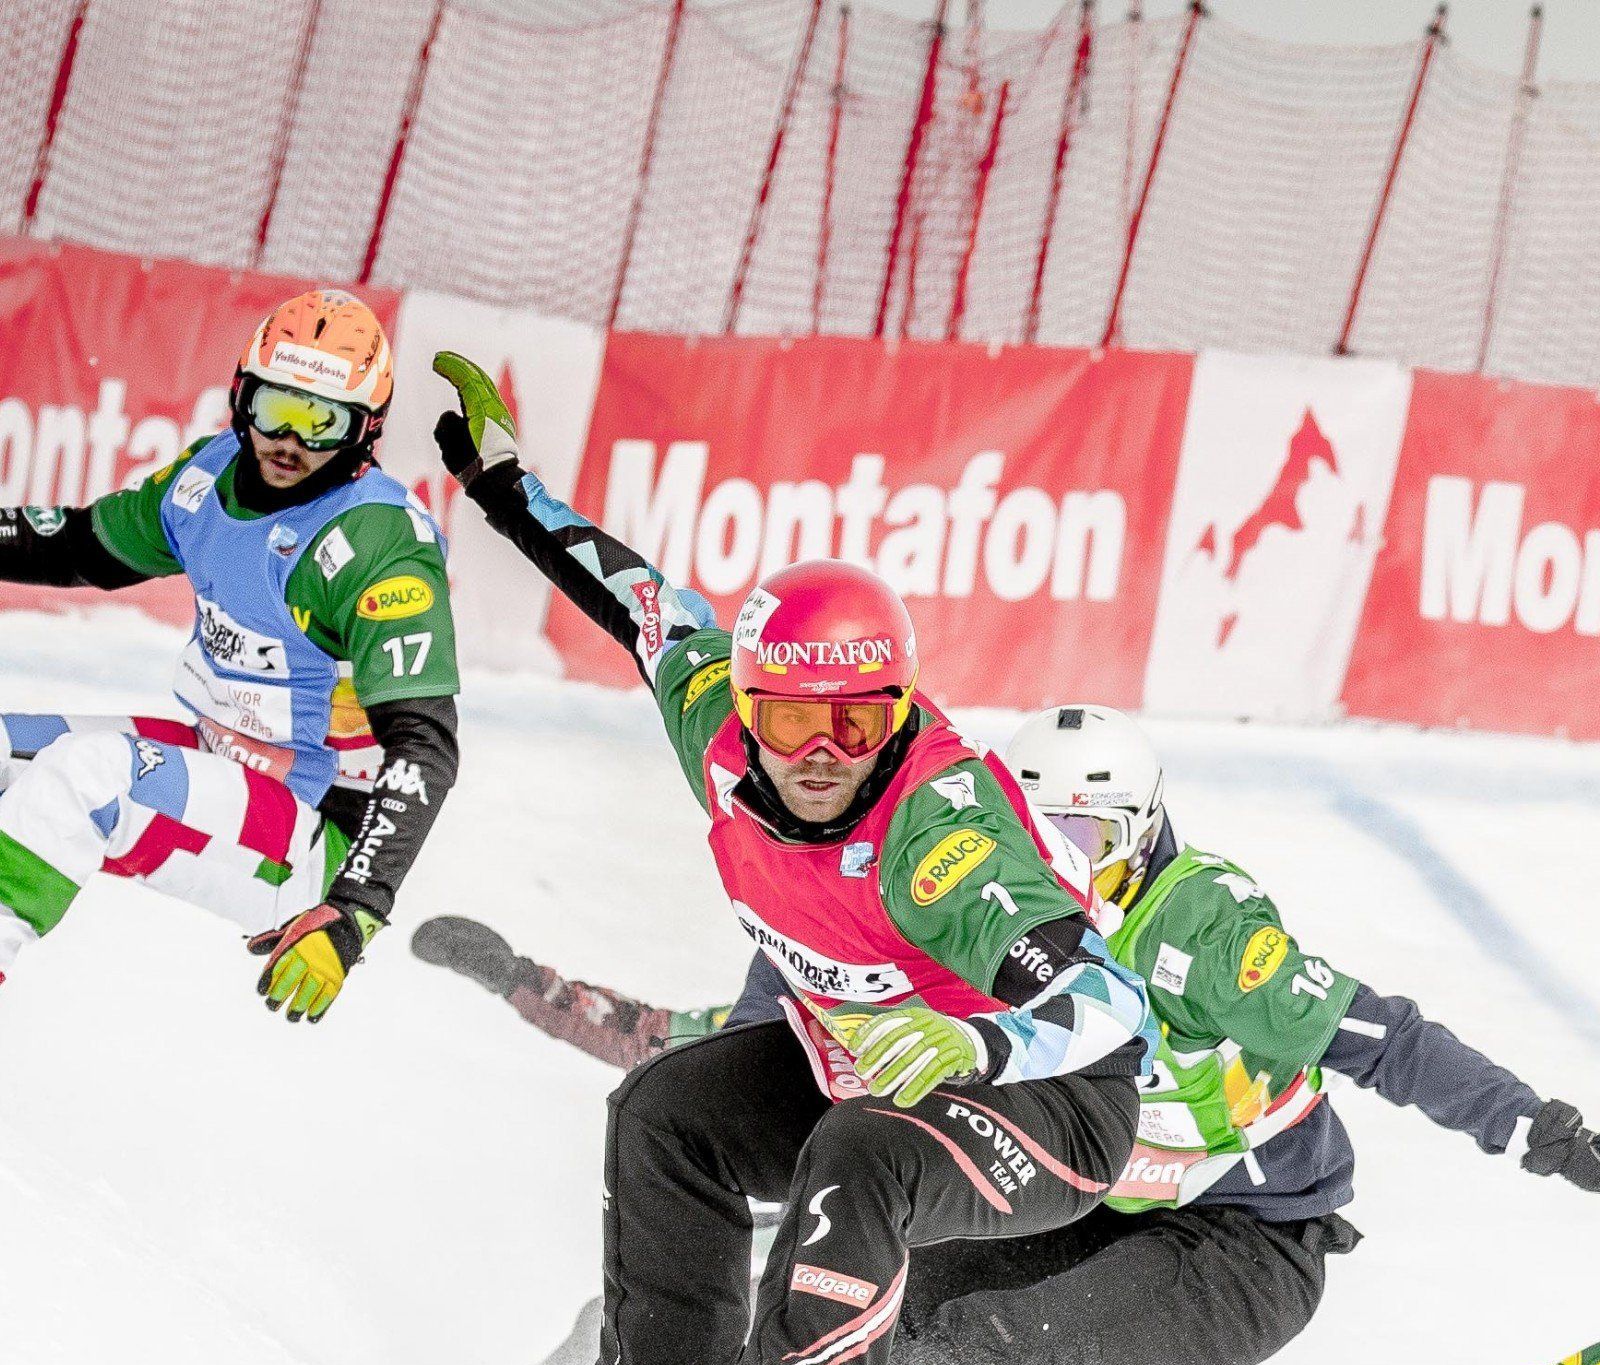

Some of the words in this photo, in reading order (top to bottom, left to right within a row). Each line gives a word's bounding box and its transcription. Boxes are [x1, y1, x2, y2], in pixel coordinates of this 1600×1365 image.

[602, 439, 1128, 601] Montafon
[379, 586, 427, 610] RAUCH
[381, 631, 433, 678] 17
[756, 638, 892, 665] MONTAFON
[344, 812, 397, 885] Audi
[929, 833, 990, 884] RAUCH
[946, 1103, 1037, 1186] POWER
[989, 1160, 1018, 1195] TEAM
[793, 1267, 870, 1301] Colgate
